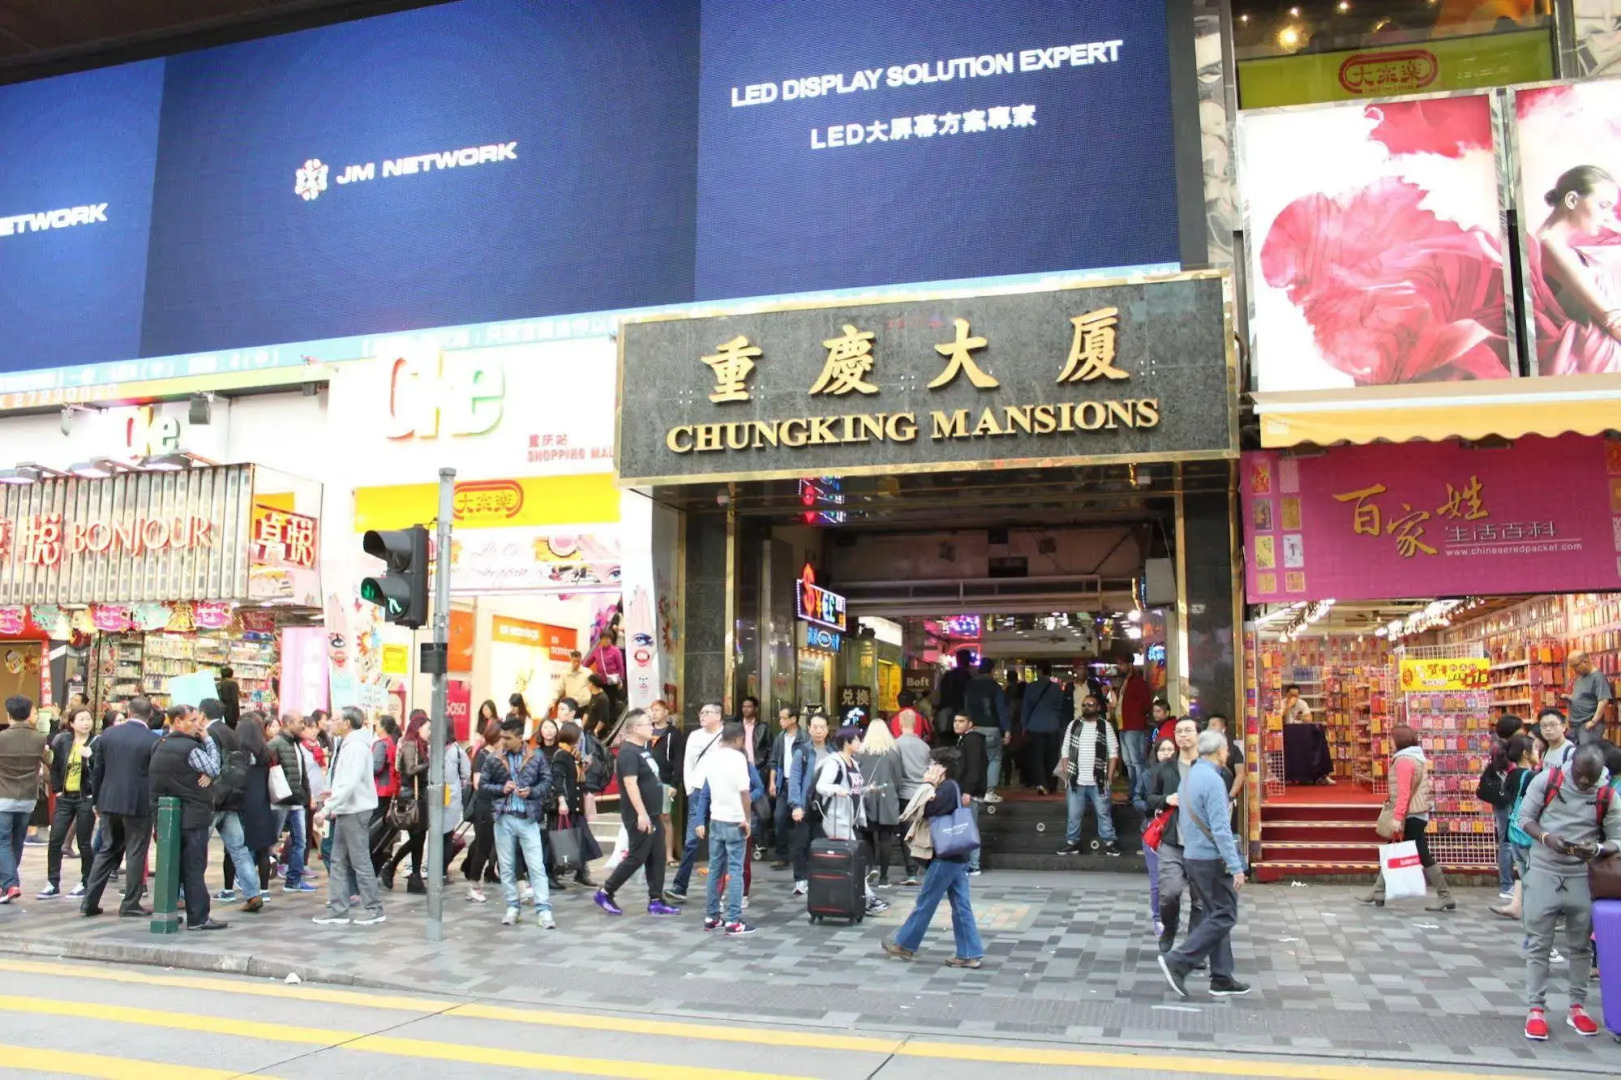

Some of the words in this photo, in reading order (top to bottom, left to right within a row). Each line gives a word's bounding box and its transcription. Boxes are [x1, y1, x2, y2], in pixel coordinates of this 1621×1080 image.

[731, 82, 778, 107] LED
[782, 68, 883, 101] DISPLAY
[886, 53, 1014, 87] SOLUTION
[1020, 40, 1123, 71] EXPERT
[336, 162, 375, 184] JM
[382, 142, 518, 178] NETWORK
[0, 203, 108, 236] ETWORK
[666, 412, 917, 453] CHUNGKING
[929, 398, 1159, 439] MANSIONS
[527, 447, 586, 463] SHOPPING
[590, 445, 613, 460] MAL
[71, 514, 214, 557] BONJOUR
[1333, 475, 1489, 557] 百家姓
[1445, 521, 1556, 542] 生活百科
[1446, 544, 1583, 557] www.chineseredpacket.com
